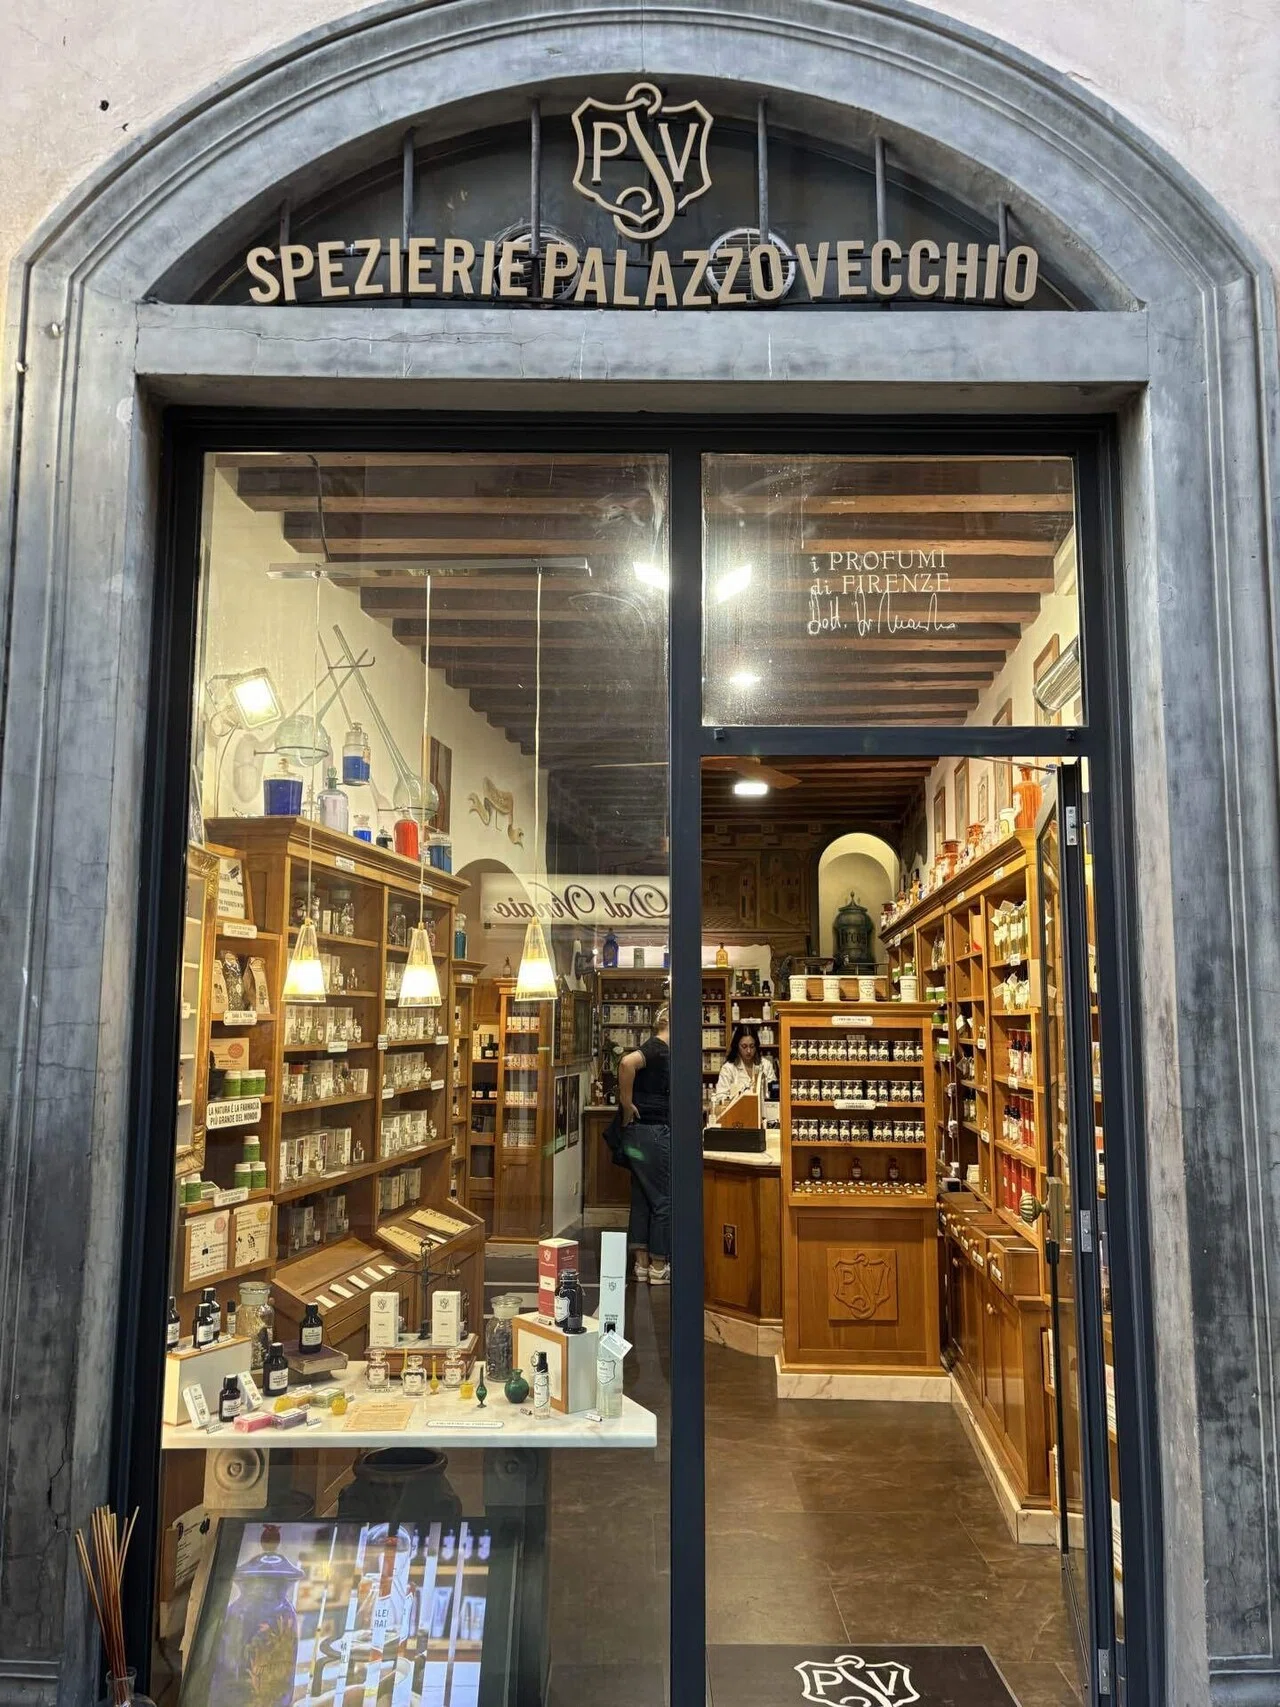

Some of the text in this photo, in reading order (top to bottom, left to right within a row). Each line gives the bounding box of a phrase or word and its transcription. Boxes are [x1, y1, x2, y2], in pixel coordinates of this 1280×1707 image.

[246, 238, 1038, 307] SPEZIERIE PALAZZO VECCHIO
[828, 549, 946, 571] PROFUMI
[810, 573, 951, 595] di FIRENZE
[215, 1105, 230, 1114] NATURA
[240, 1102, 259, 1111] FARMACIA
